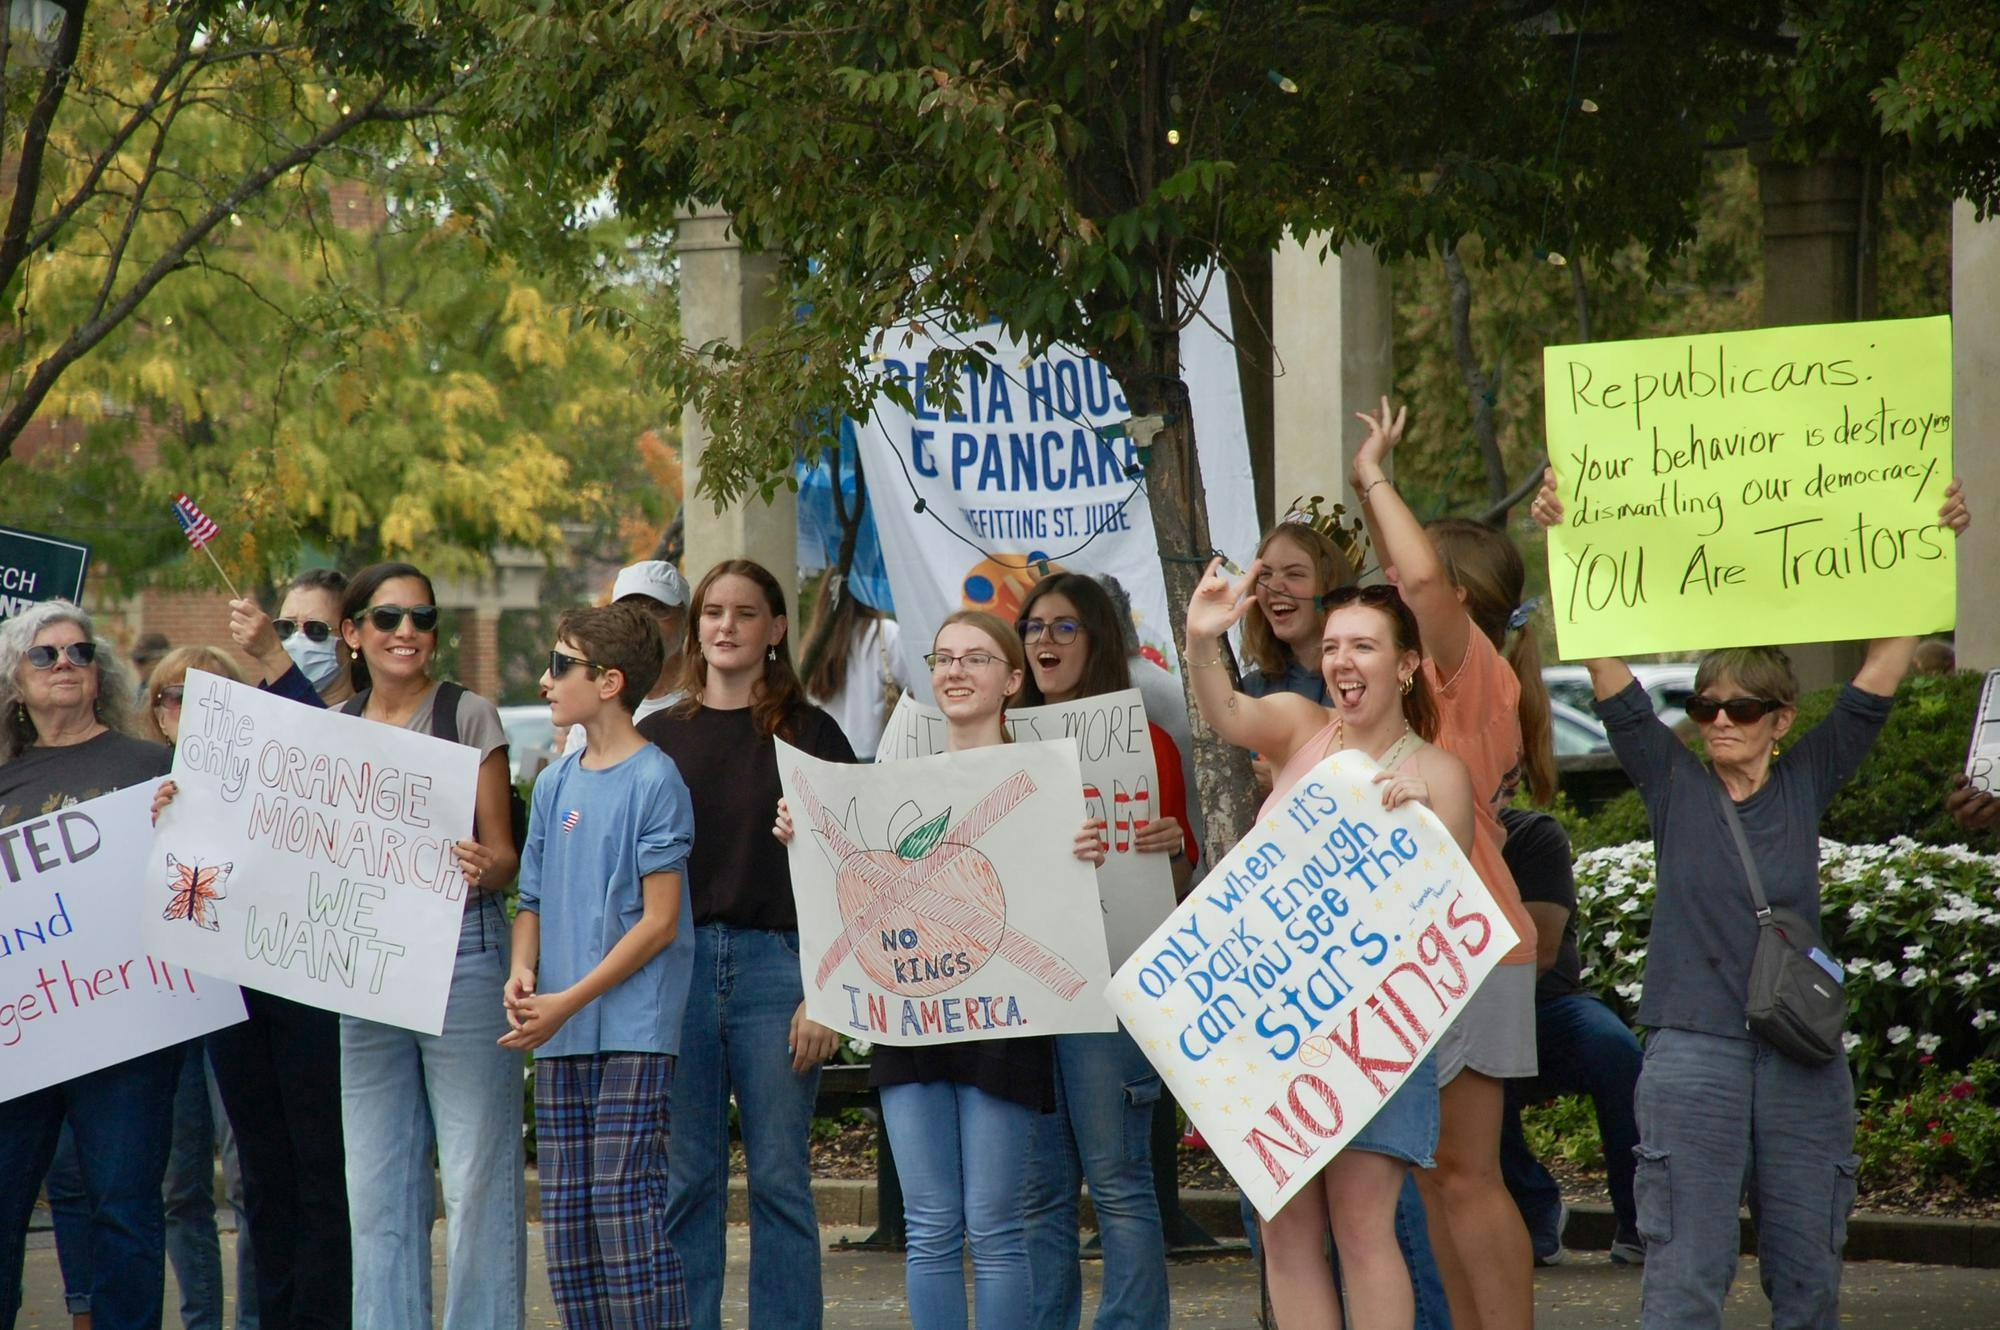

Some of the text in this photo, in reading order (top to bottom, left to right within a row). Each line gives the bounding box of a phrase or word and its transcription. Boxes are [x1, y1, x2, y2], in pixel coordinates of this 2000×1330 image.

[1569, 344, 1876, 430] Republicans:
[1653, 424, 1785, 475] behavior
[1806, 428, 1824, 447] is
[1834, 397, 1950, 450] destroying
[1054, 507, 1078, 537] ST.
[1084, 500, 1131, 535] JUDE
[1572, 480, 1724, 536] dismantling
[1564, 512, 1948, 623] YOU Are Traitors.
[199, 681, 254, 747] the
[1062, 704, 1143, 762] MORE
[182, 734, 432, 828] only ORANGE
[248, 793, 466, 901] MONARCH
[1260, 818, 1380, 922] Enough
[1345, 827, 1418, 893] The
[308, 872, 385, 937] WE
[245, 905, 405, 995] WANT
[881, 928, 918, 951] NO
[893, 951, 971, 984] KINGS
[842, 984, 1028, 1036] IN AMERICA.
[1242, 1073, 1345, 1193] NO
